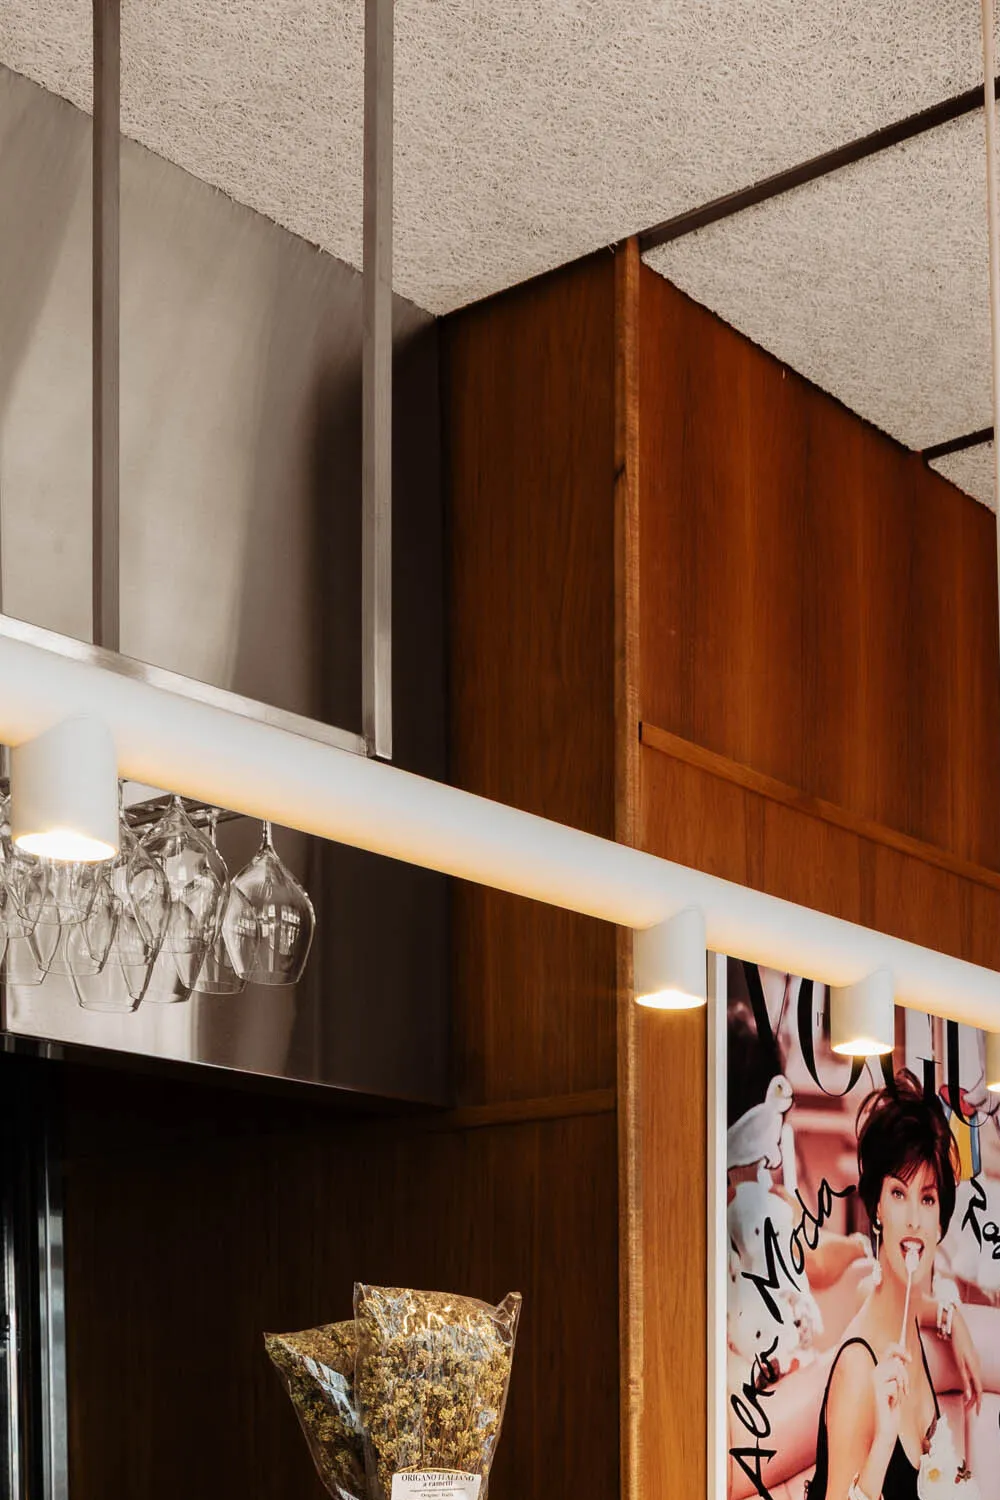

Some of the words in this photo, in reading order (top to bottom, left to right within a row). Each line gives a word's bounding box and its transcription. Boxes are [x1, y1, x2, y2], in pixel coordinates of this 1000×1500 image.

[742, 1178, 857, 1325] Moda
[401, 1474, 437, 1482] ORIGANO
[437, 1474, 475, 1482] ITALIANO
